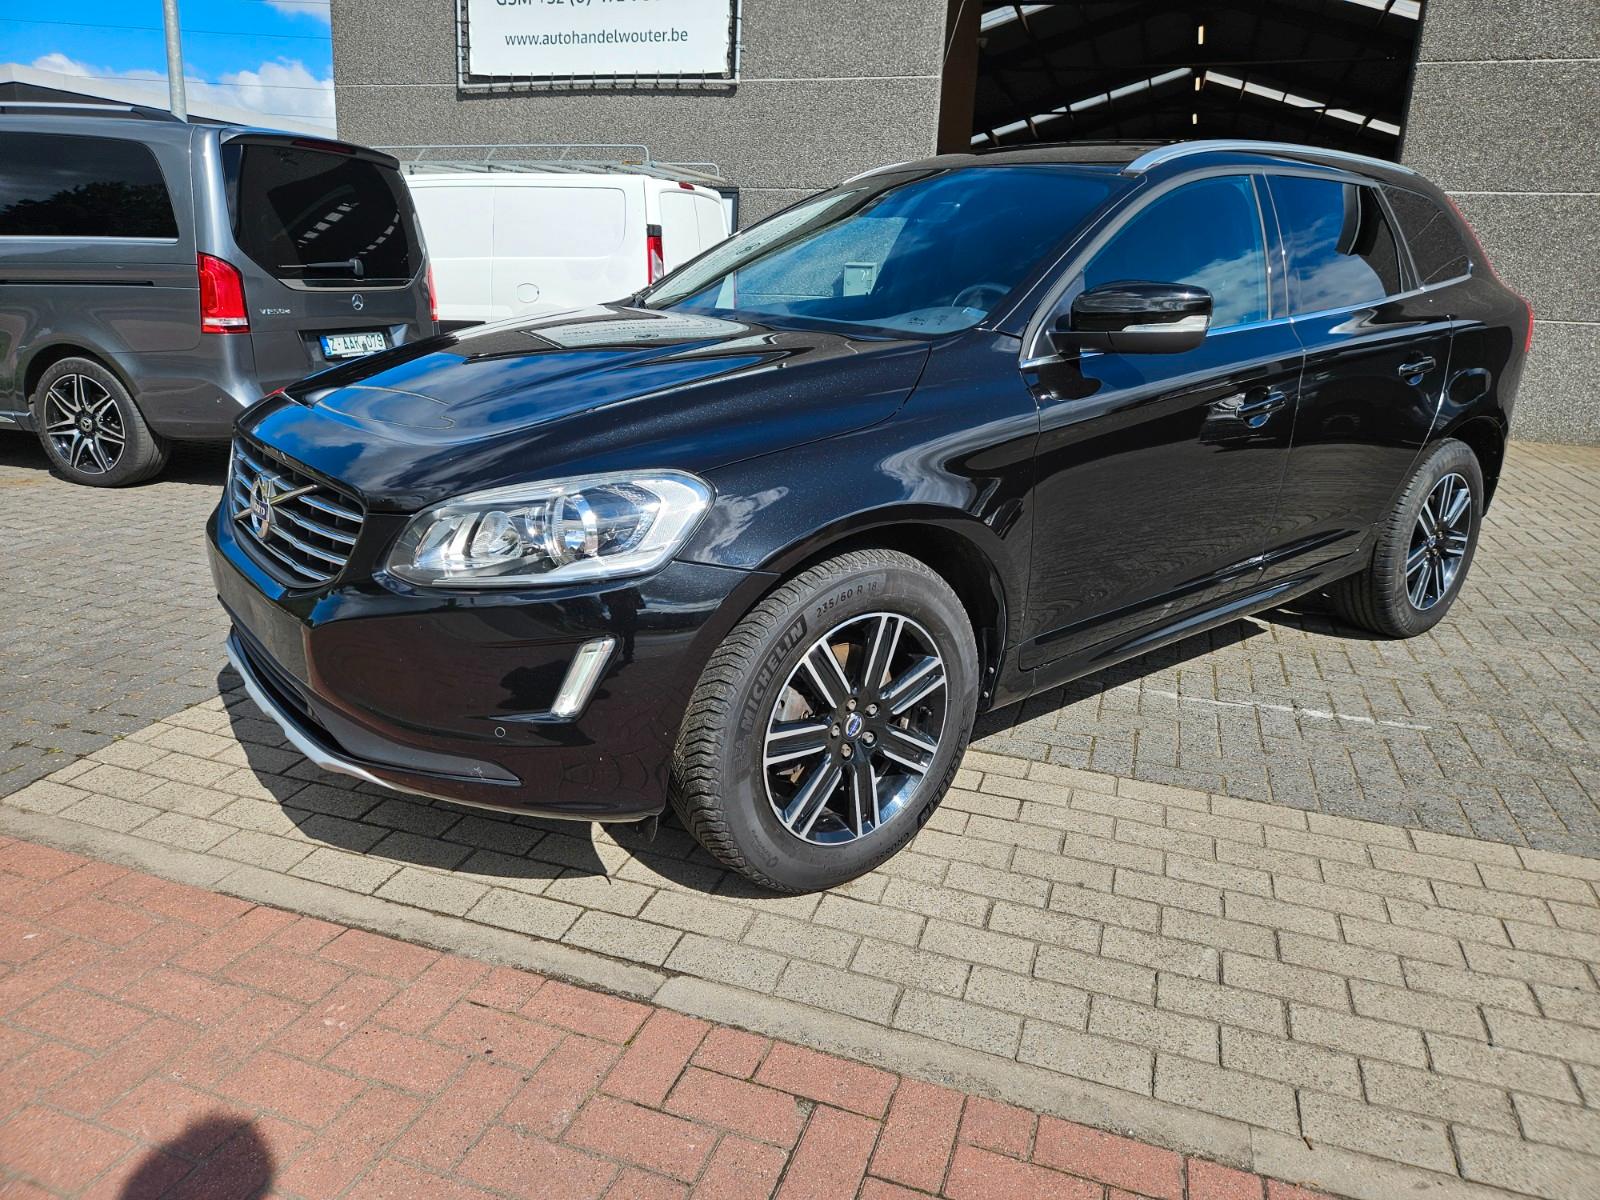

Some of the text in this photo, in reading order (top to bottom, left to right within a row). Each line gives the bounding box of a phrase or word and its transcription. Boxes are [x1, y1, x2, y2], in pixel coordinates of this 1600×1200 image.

[504, 27, 689, 46] www.autohandelwouter.be
[816, 588, 854, 618] 235/60
[856, 584, 864, 595] R
[740, 618, 806, 730] MICHELIN
